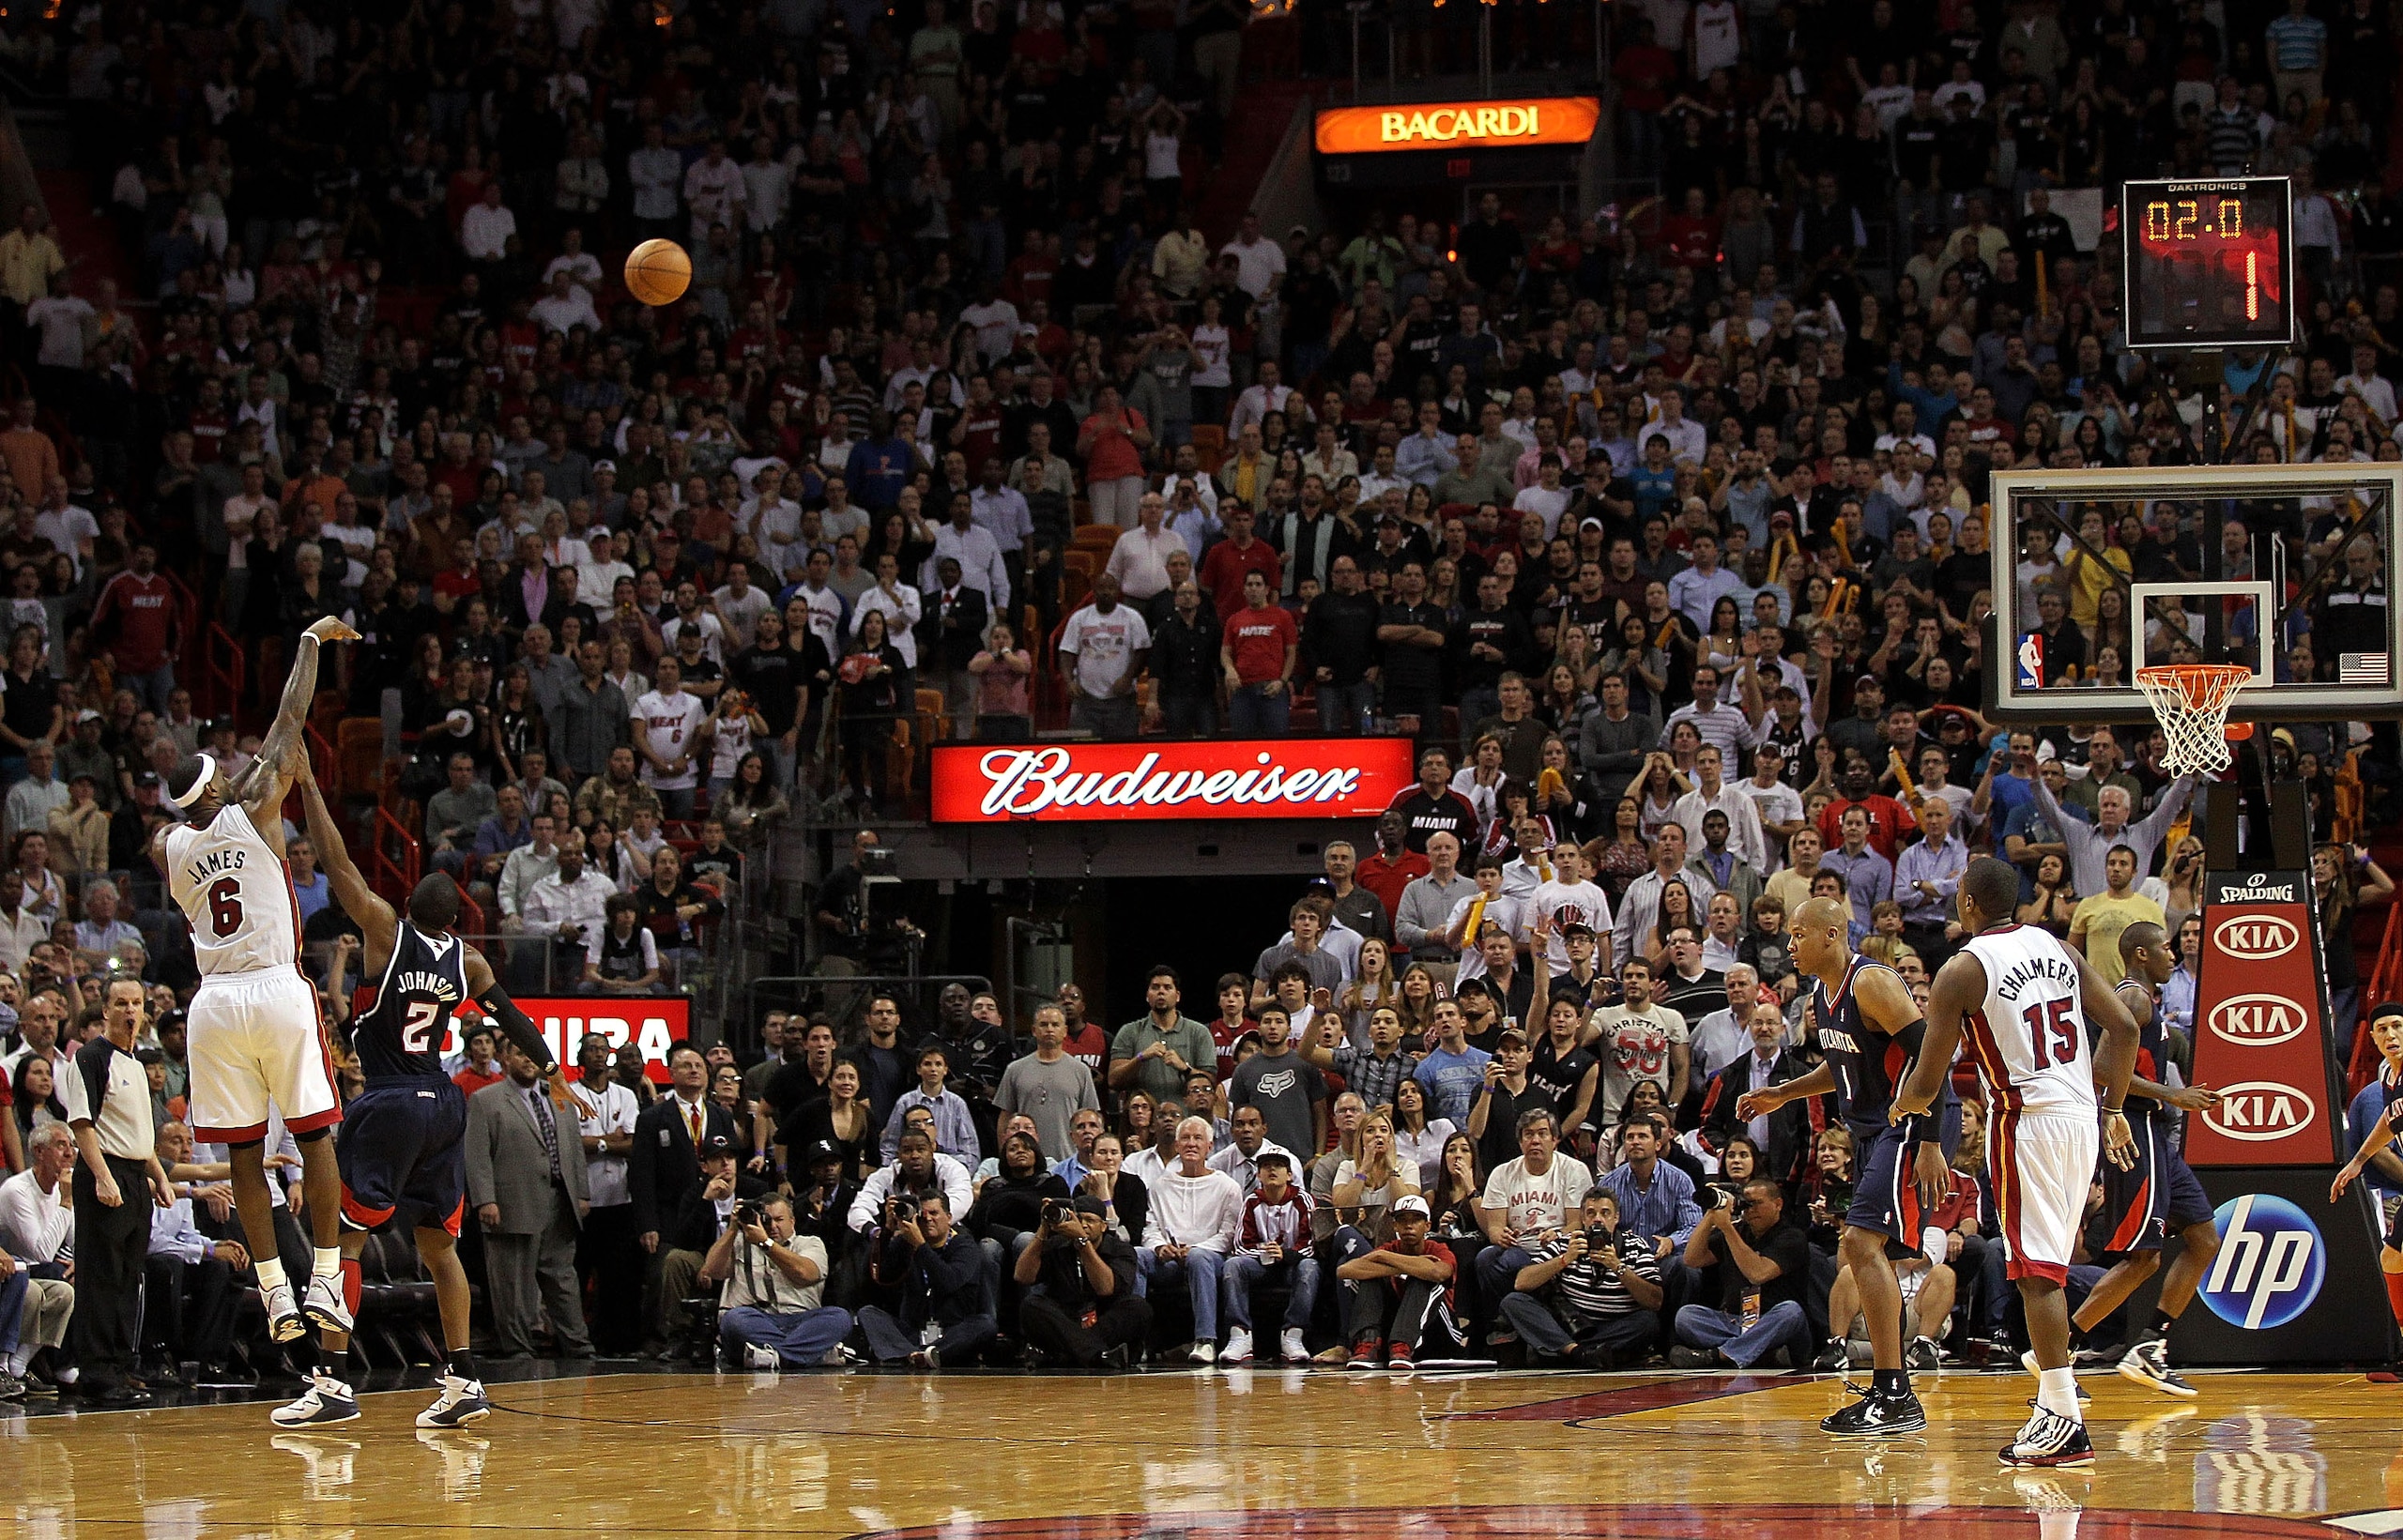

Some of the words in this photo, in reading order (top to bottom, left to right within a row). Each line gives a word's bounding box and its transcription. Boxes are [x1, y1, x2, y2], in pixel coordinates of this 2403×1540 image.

[1381, 105, 1540, 143] BACARDI
[2168, 182, 2247, 191] DAKTRONICS
[2245, 250, 2258, 321] 1
[671, 729, 681, 744] 6
[1780, 739, 1803, 758] EAT
[979, 747, 1362, 816] Budweiser
[1788, 759, 1800, 776] 6
[1411, 816, 1458, 830] MIAMI
[189, 851, 245, 884] JAMES
[208, 876, 244, 938] 6
[2220, 884, 2294, 904] SPALDING
[2228, 925, 2286, 949] KIA
[398, 970, 458, 1002] JOHNSON
[1997, 958, 2077, 1001] CHALMERS
[401, 999, 441, 1054] 2
[2022, 995, 2078, 1072] 15
[2227, 1006, 2292, 1033] KIA
[1840, 1064, 1852, 1101] 1
[2223, 1096, 2297, 1126] KIA
[1510, 1190, 1559, 1208] MIAMI
[2206, 1194, 2314, 1330] hp
